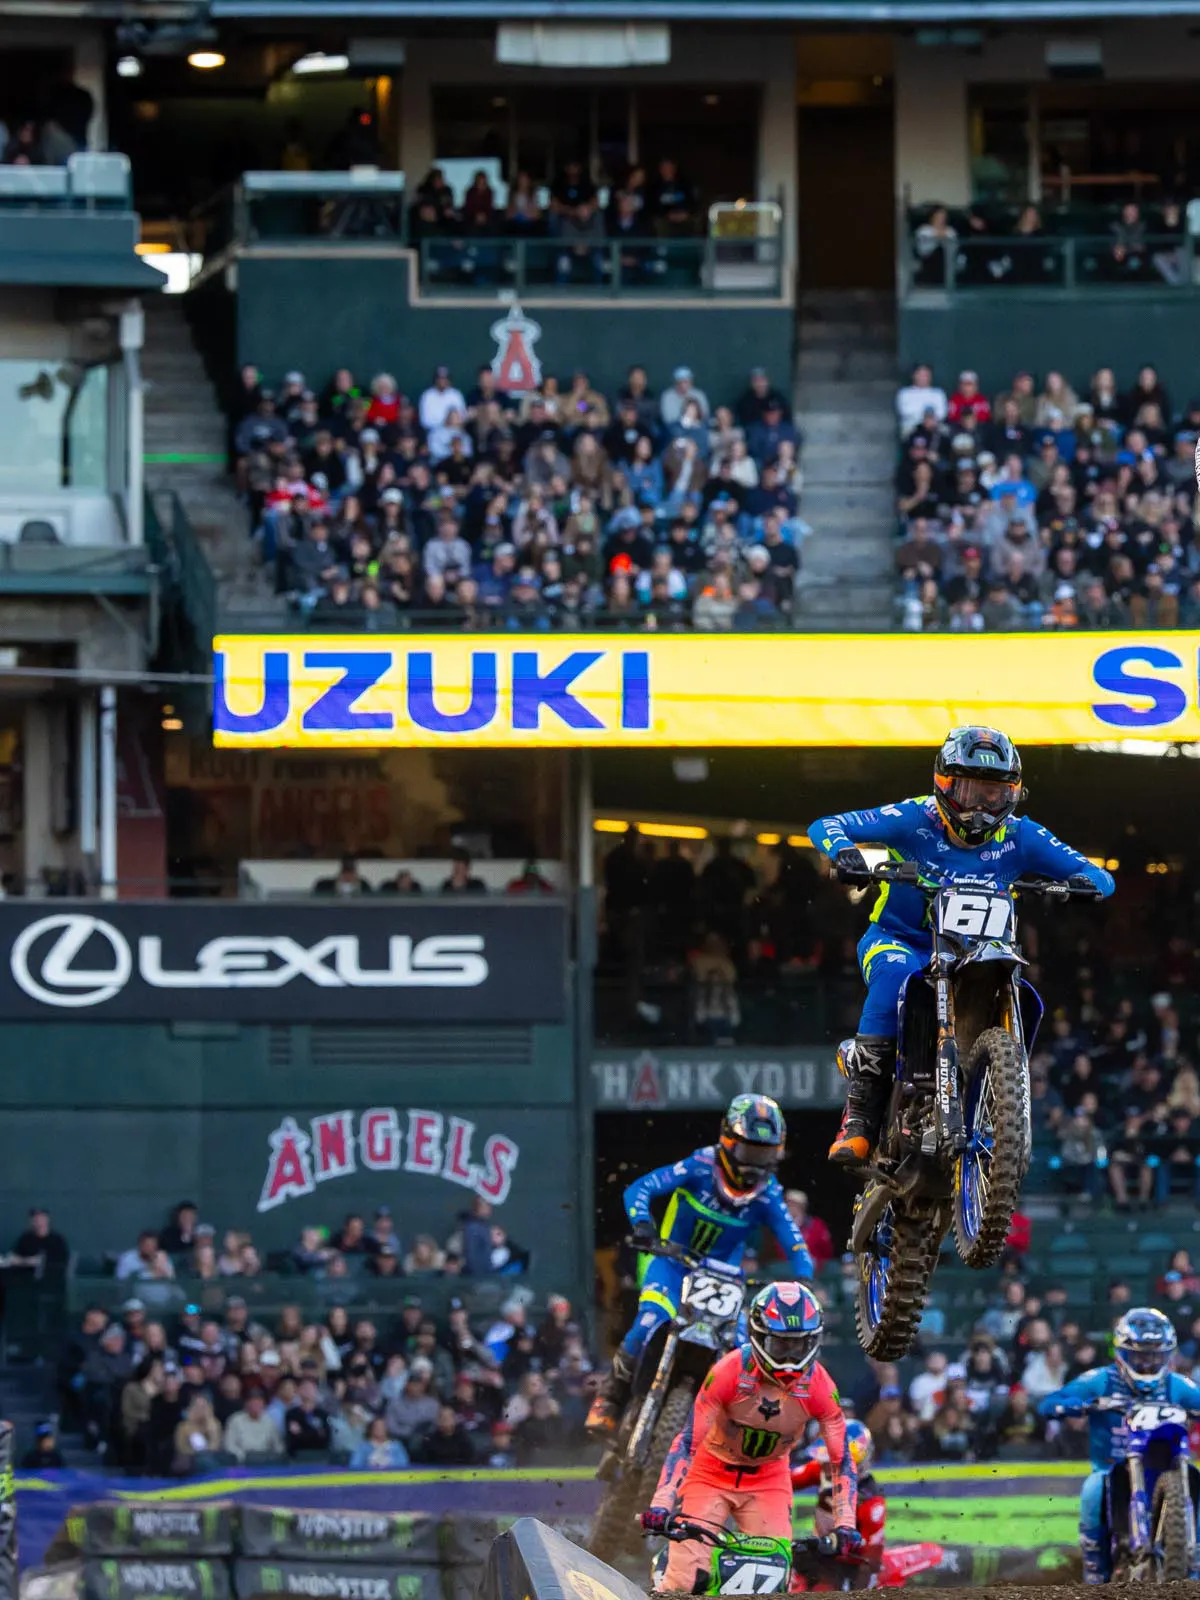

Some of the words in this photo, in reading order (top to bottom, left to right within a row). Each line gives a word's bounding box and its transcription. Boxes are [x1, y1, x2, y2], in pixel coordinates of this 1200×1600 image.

[943, 895, 1010, 937] 61
[138, 934, 489, 988] LEXUS
[940, 1058, 949, 1114] DUNLOP
[257, 1107, 520, 1213] ANGELS
[687, 1277, 742, 1316] 23
[1129, 1405, 1188, 1431] 42
[720, 1562, 786, 1595] 47
